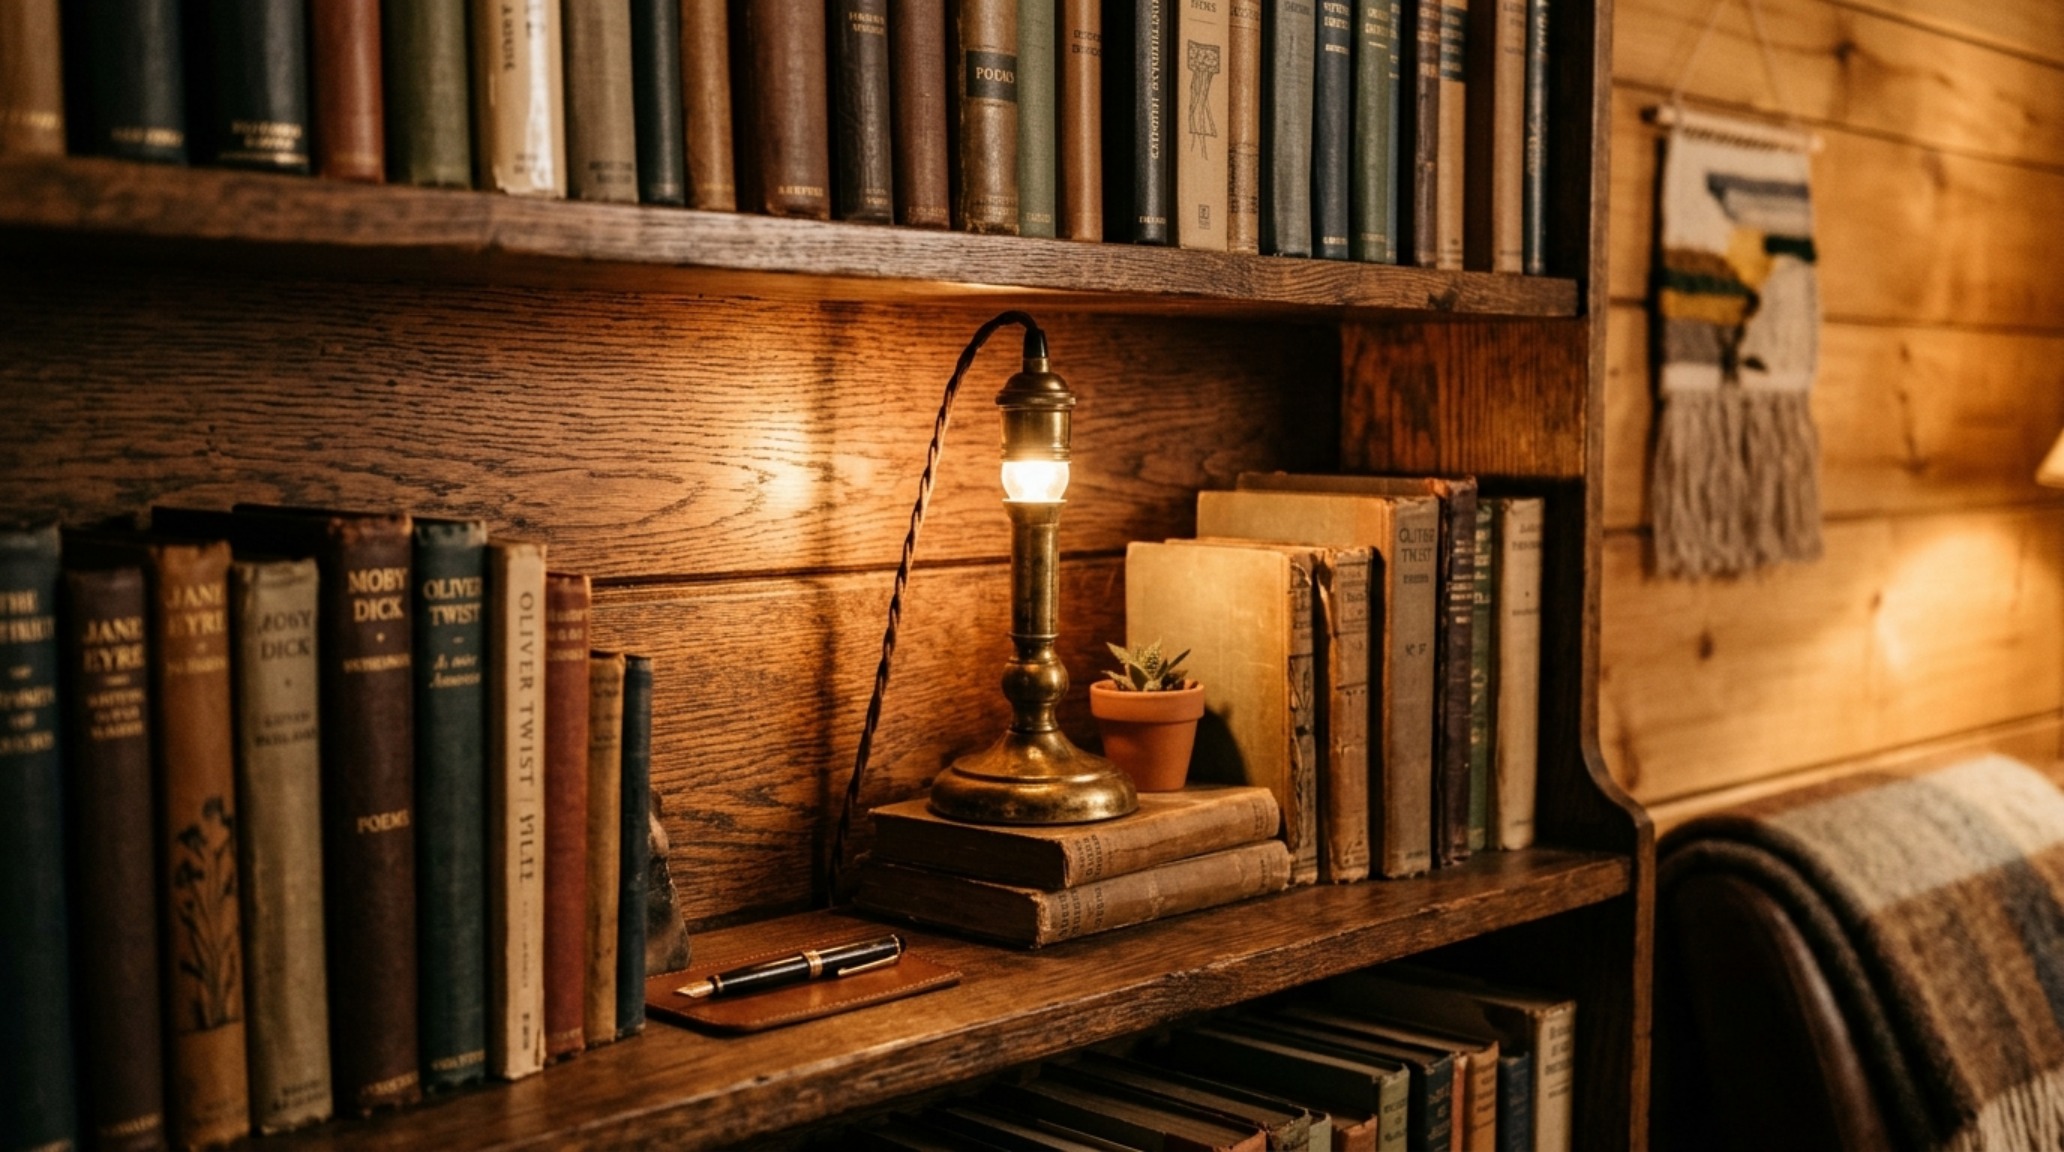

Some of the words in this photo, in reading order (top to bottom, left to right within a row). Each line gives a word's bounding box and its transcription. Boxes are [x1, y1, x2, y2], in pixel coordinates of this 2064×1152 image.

[347, 567, 409, 594] MOBY
[353, 596, 405, 623] DICK
[428, 602, 482, 626] TWIST
[260, 637, 312, 661] DICK
[518, 591, 535, 692] OLIVER
[518, 701, 535, 787] TWIST
[356, 809, 411, 834] POEMS
